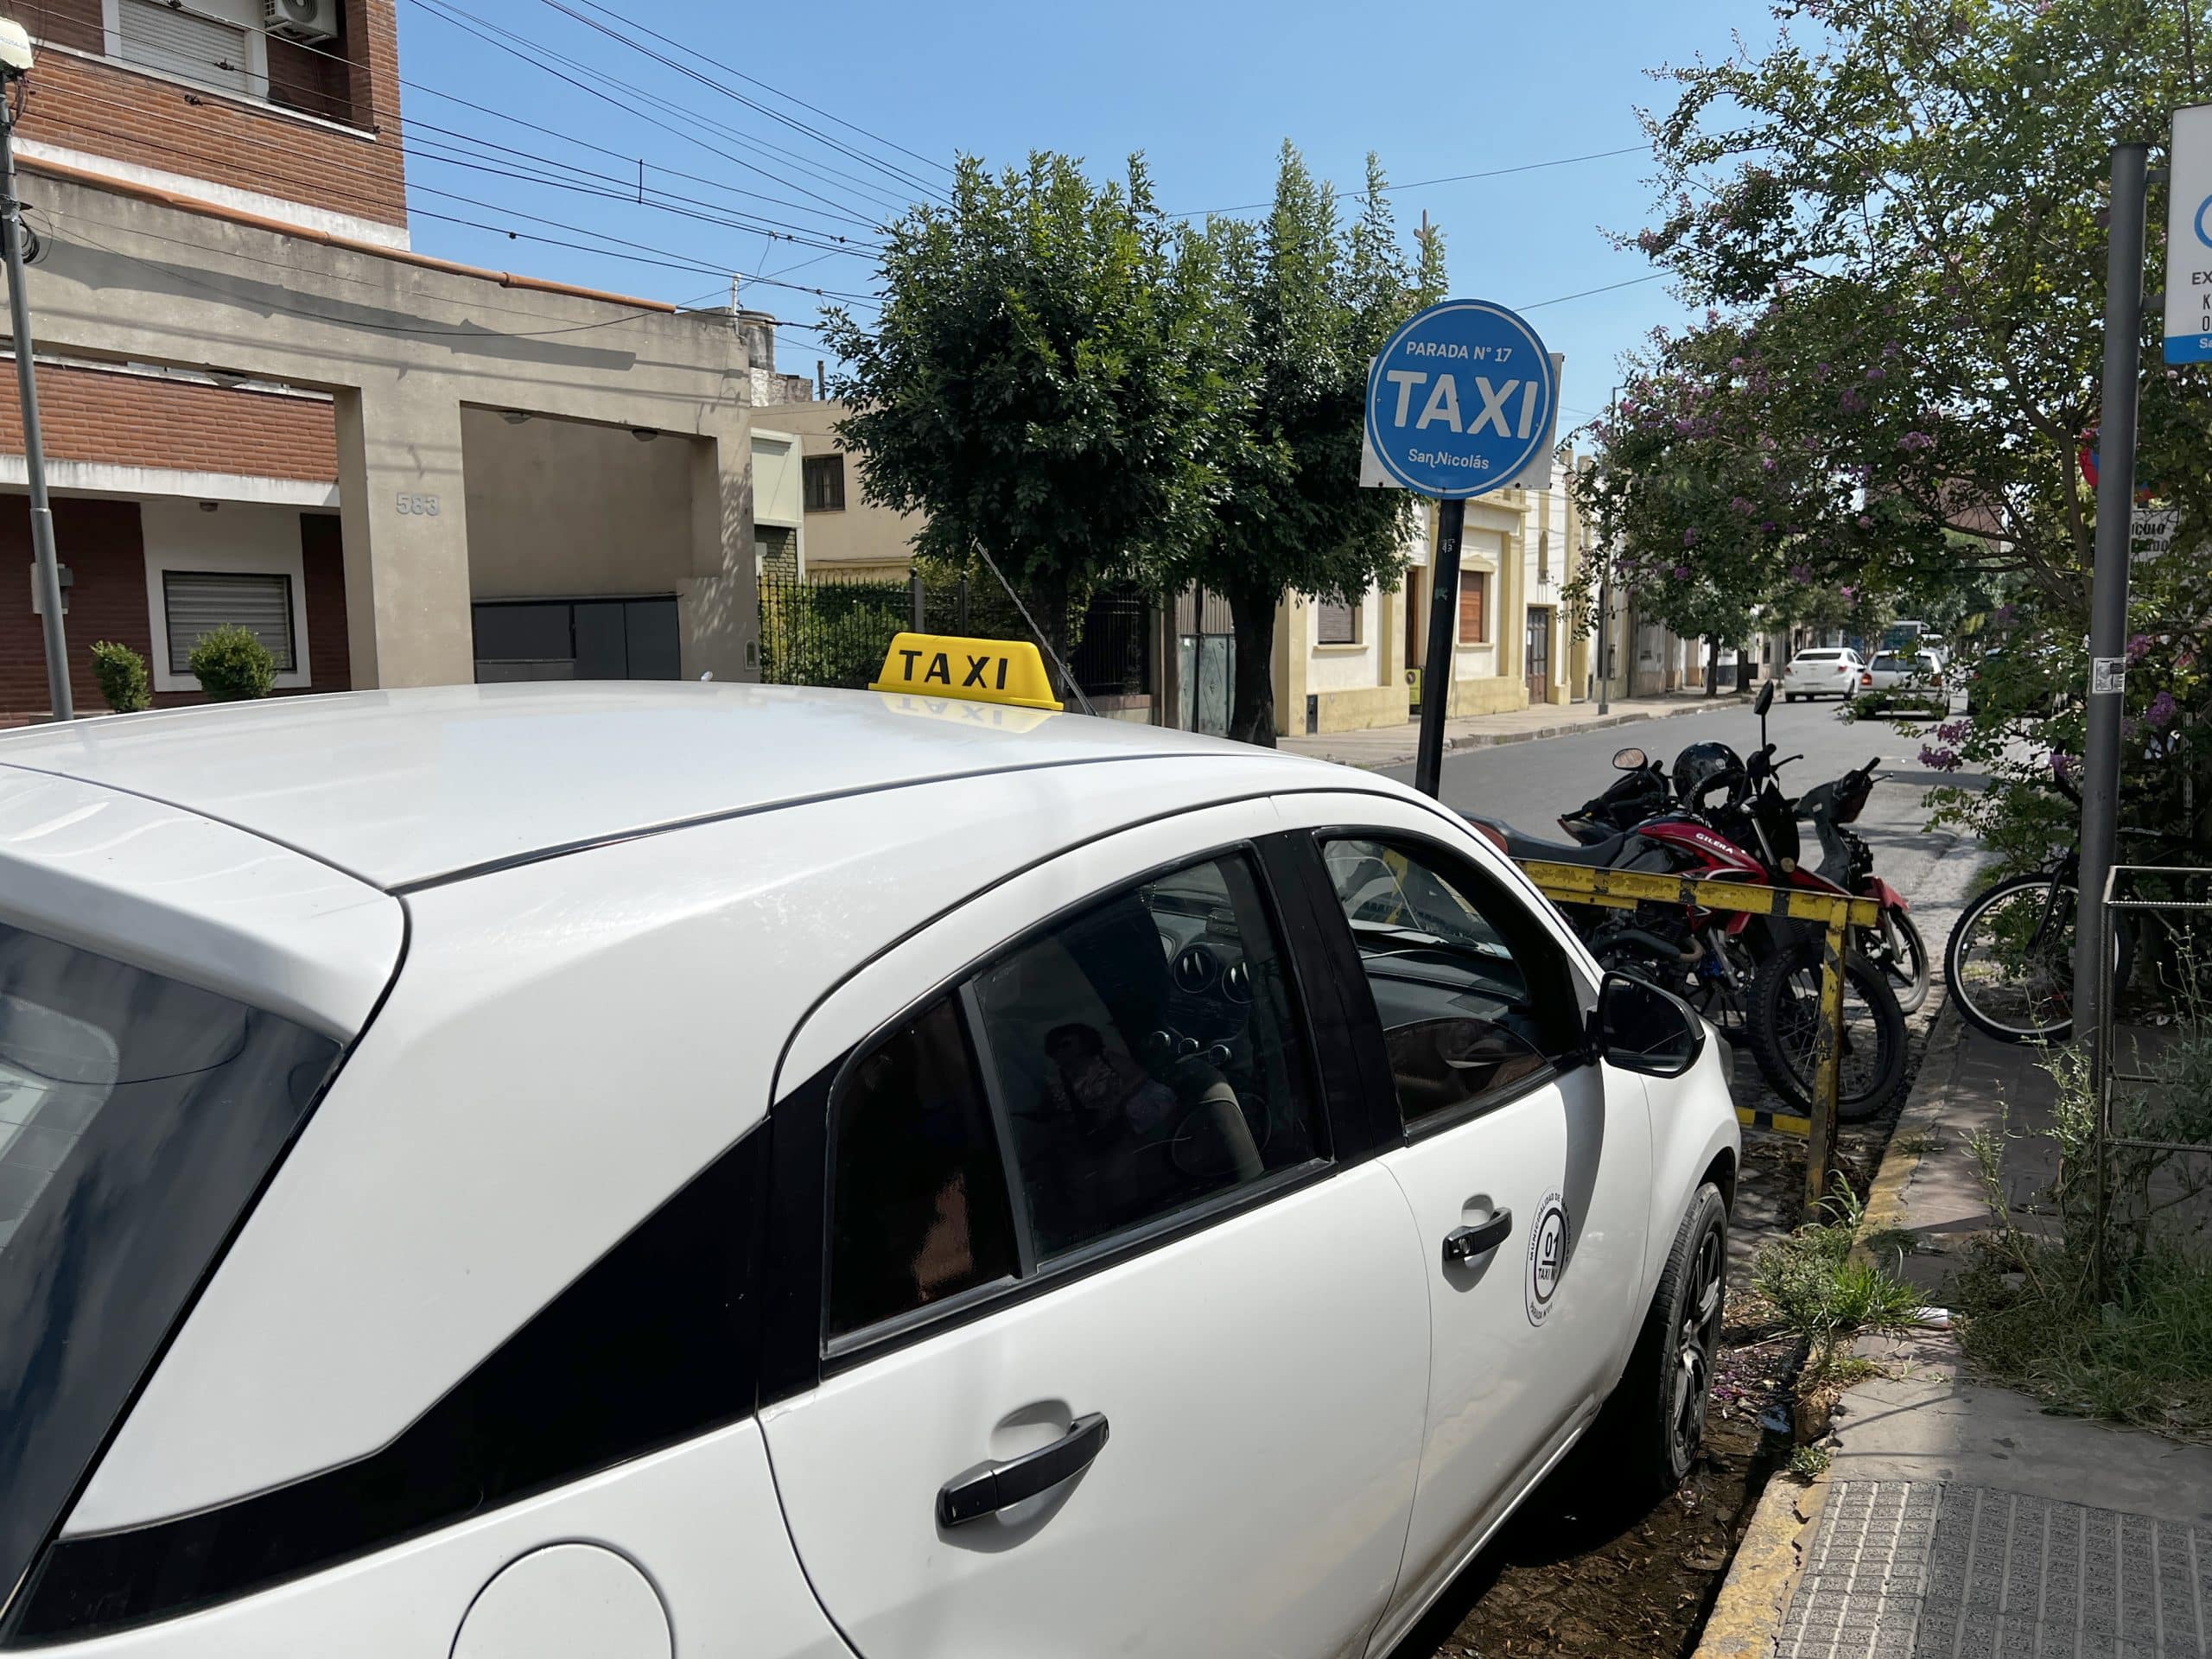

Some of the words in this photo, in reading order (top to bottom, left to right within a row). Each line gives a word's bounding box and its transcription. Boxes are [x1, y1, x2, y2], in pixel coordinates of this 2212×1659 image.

[1406, 341, 1469, 359] PARADA
[1473, 347, 1491, 360] N°
[1495, 347, 1512, 363] 17
[1387, 370, 1538, 440] TAXI
[899, 650, 1008, 690] TAXI
[1695, 833, 1733, 855] GILERA
[1530, 1192, 1554, 1261] MUNICIPALIDAD
[1545, 1231, 1560, 1258] 01
[1538, 1268, 1550, 1281] TAXI
